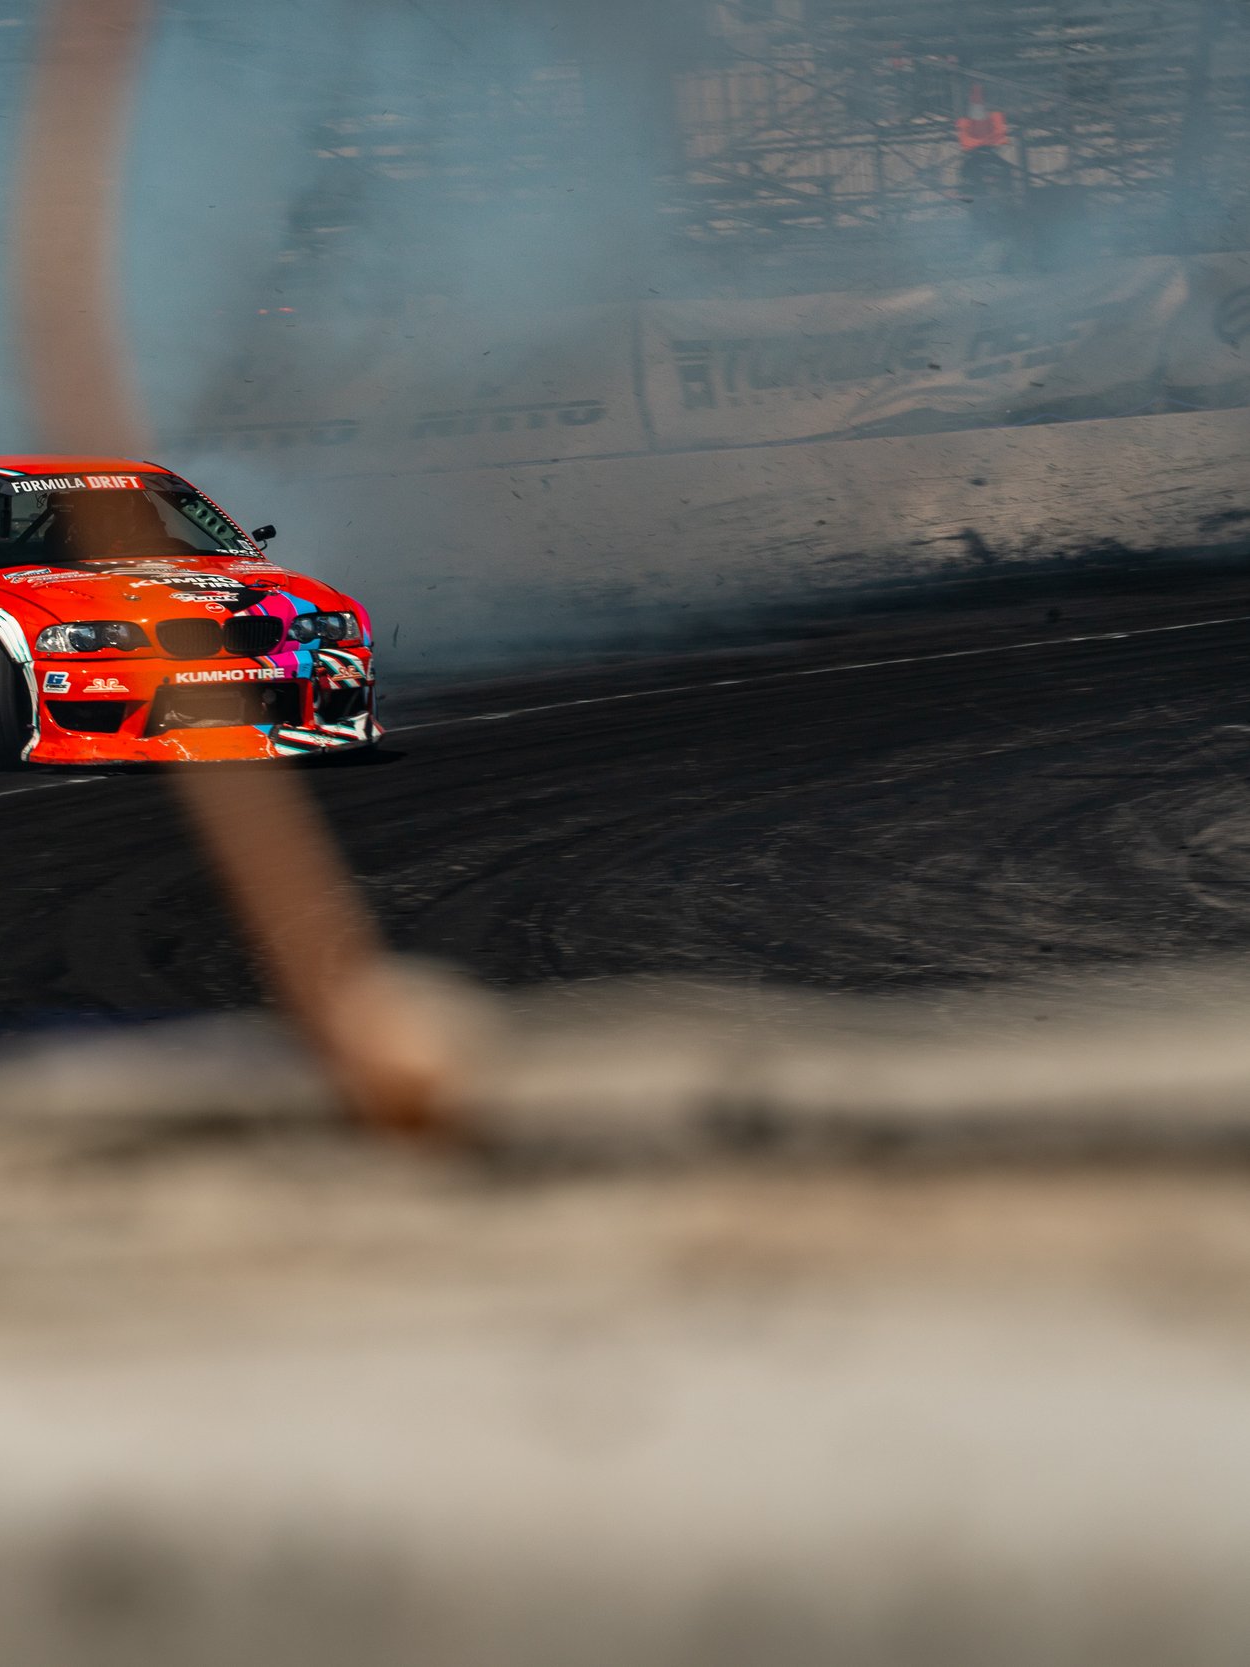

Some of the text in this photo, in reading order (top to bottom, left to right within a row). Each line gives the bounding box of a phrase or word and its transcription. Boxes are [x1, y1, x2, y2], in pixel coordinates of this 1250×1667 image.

[11, 475, 140, 494] FORMULA DRIFT
[128, 577, 240, 588] KUMHO
[176, 668, 285, 683] KUMHO TIRE
